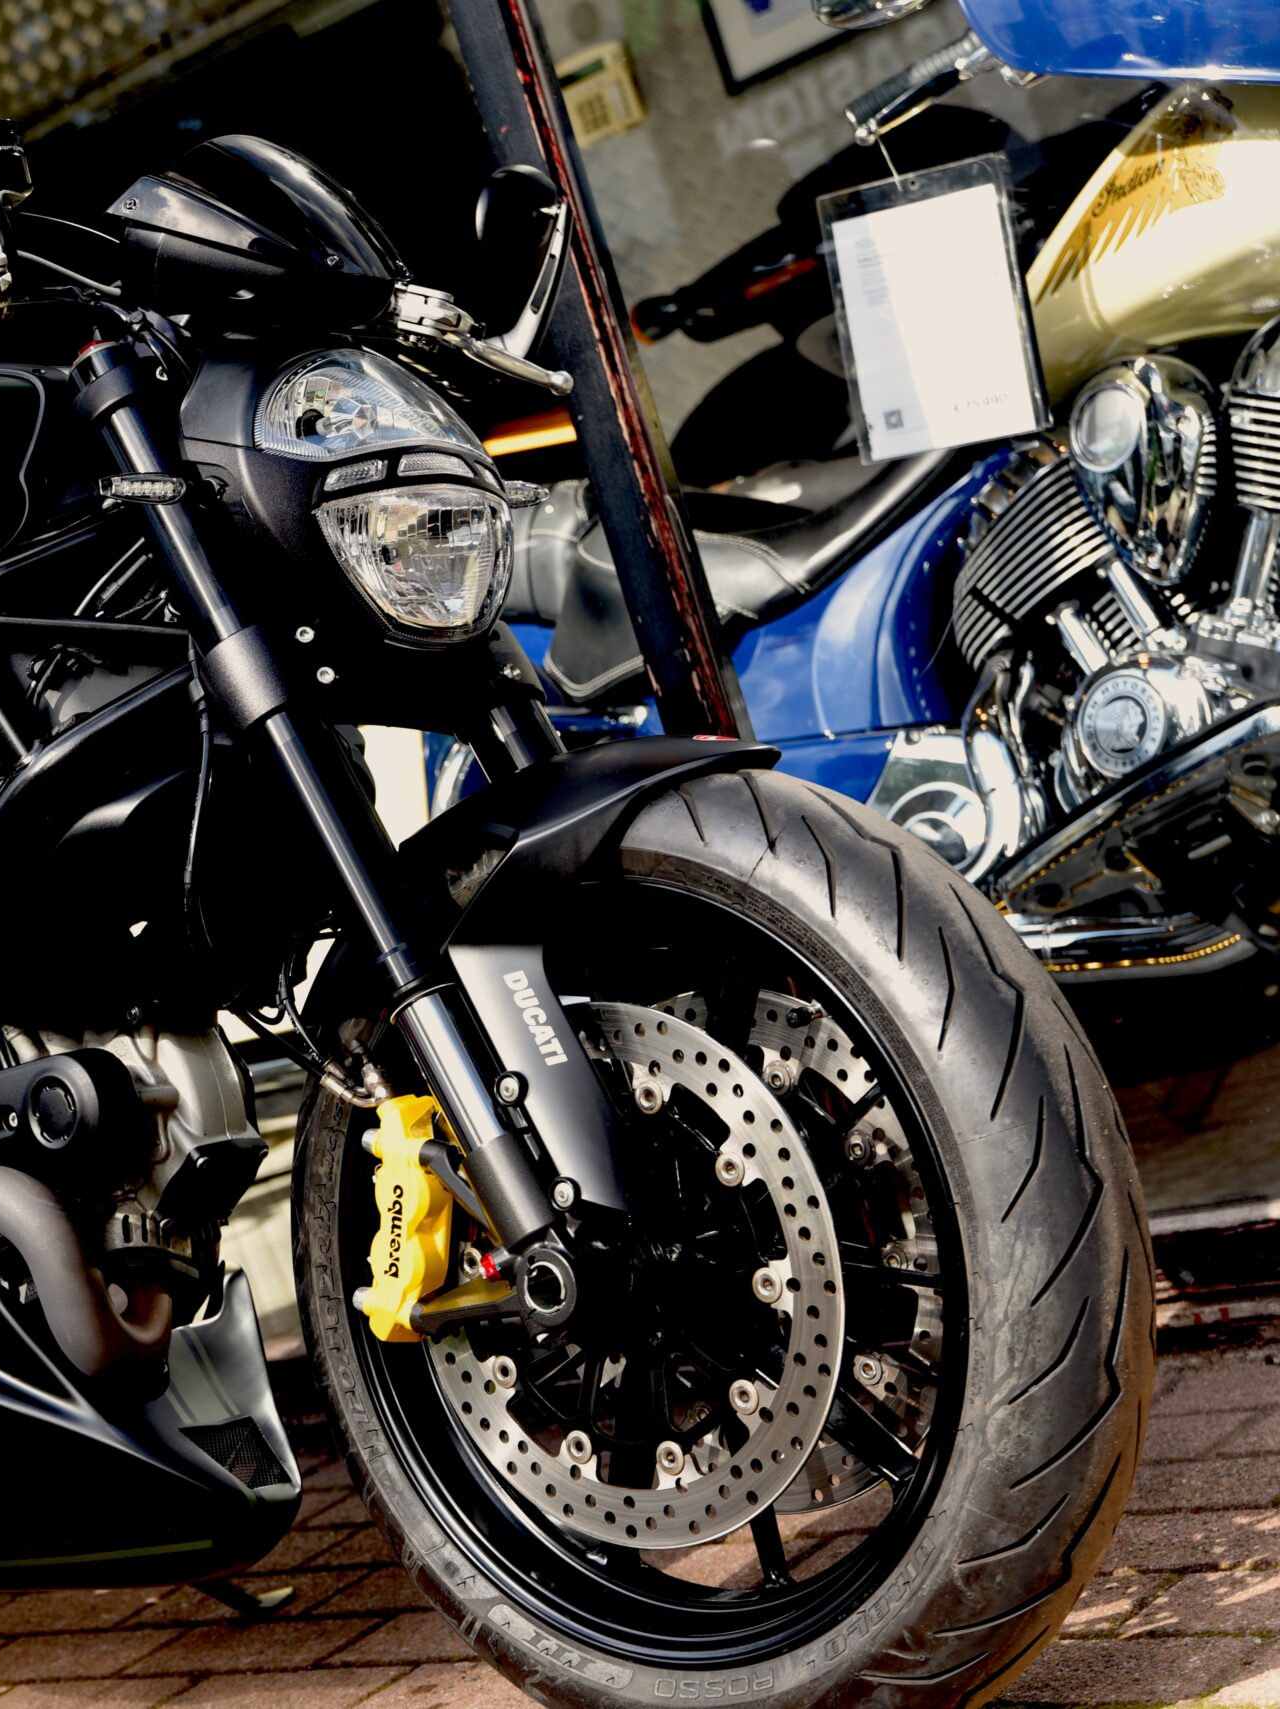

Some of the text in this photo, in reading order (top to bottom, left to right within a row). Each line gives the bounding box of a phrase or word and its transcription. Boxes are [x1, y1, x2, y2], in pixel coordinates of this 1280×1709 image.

[1091, 158, 1166, 218] Indian
[502, 969, 568, 1067] DUCATI
[384, 1184, 404, 1279] brembo
[823, 1534, 937, 1662] DIABLO
[654, 1666, 775, 1700] ROSSO
